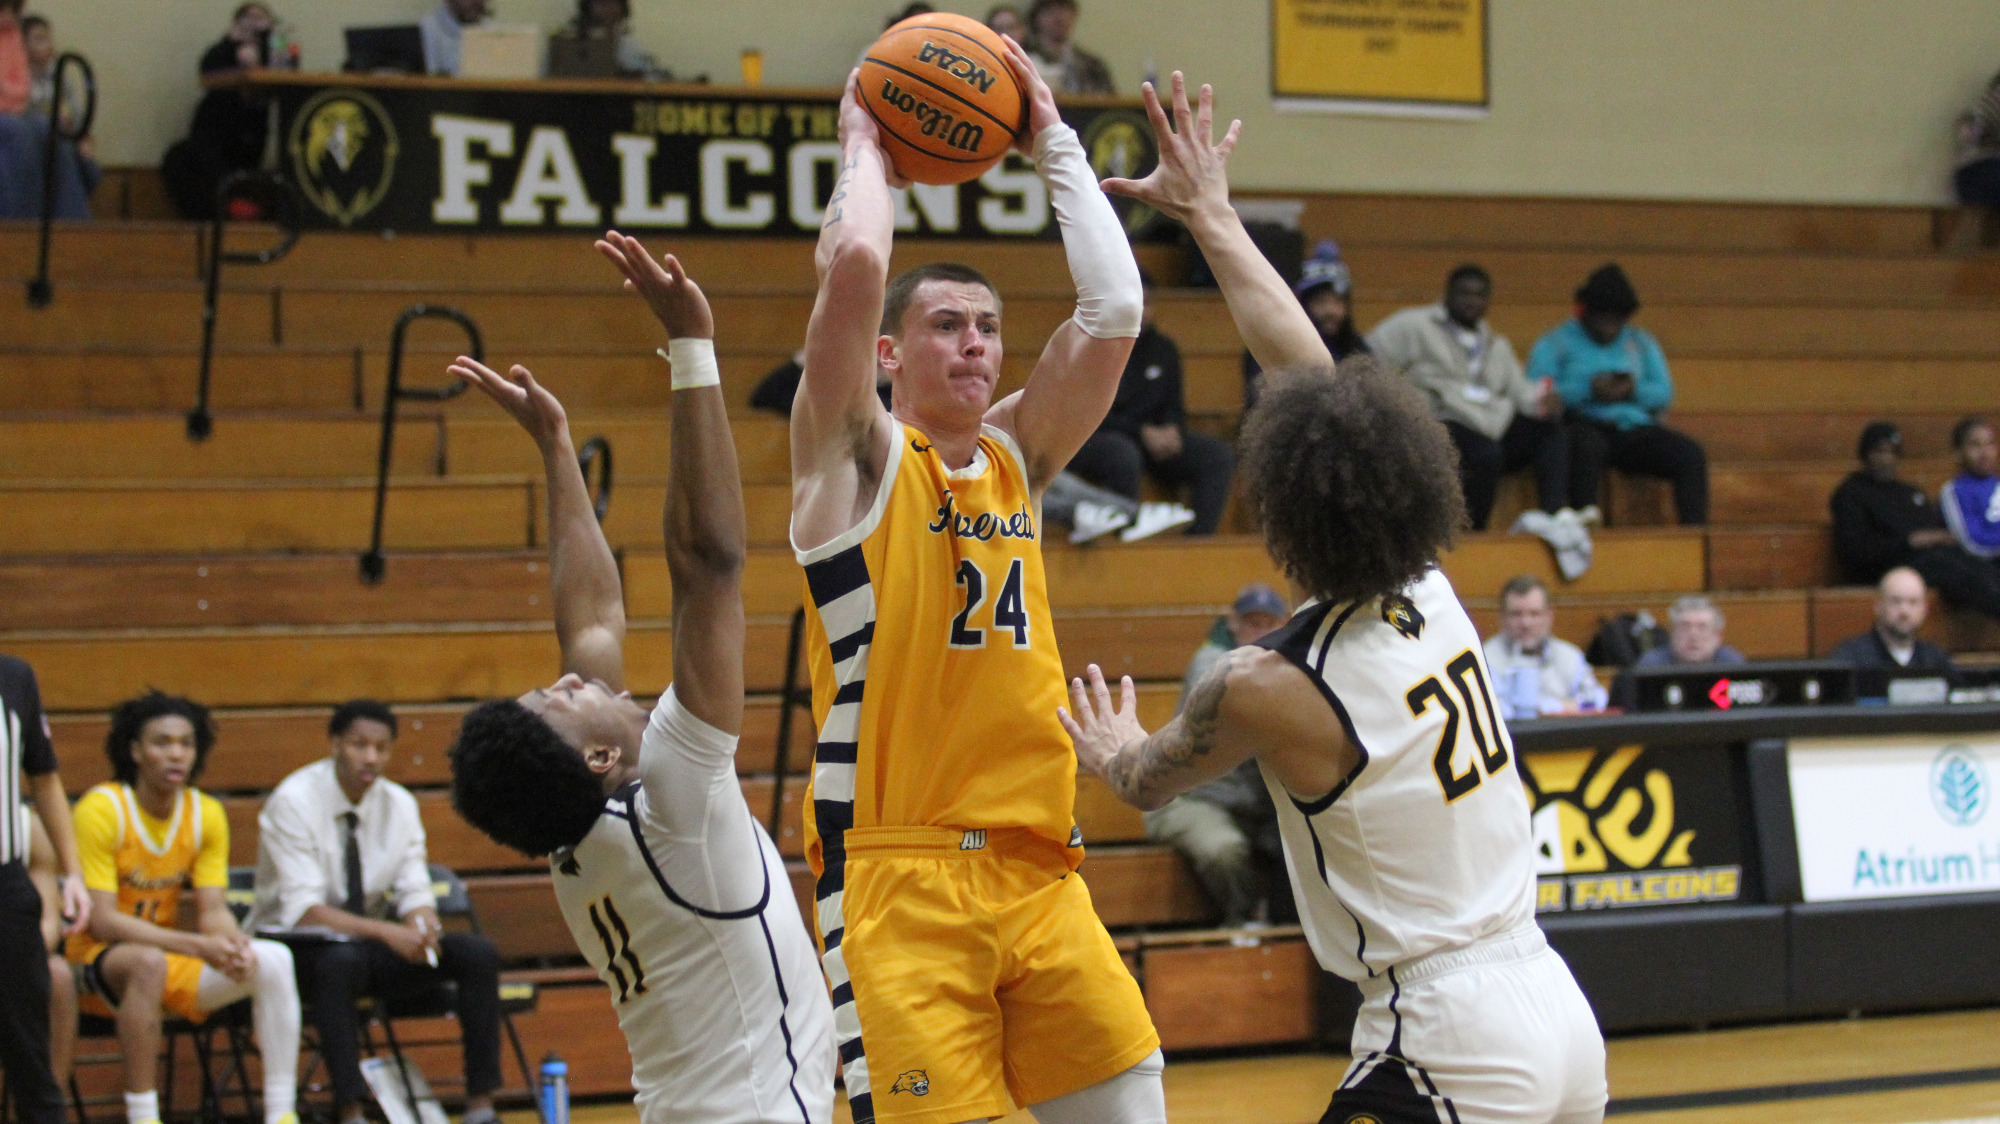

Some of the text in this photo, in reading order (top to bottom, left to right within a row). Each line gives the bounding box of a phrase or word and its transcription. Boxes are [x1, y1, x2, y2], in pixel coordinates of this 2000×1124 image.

[917, 40, 997, 94] NCAA
[633, 101, 733, 136] HOME
[880, 78, 984, 153] Wilson
[948, 556, 1032, 649] 24
[1403, 646, 1509, 806] 20
[959, 828, 987, 851] AU
[1853, 844, 1976, 888] Atrium
[1569, 865, 1742, 910] FALCONS
[588, 892, 649, 1004] 11
